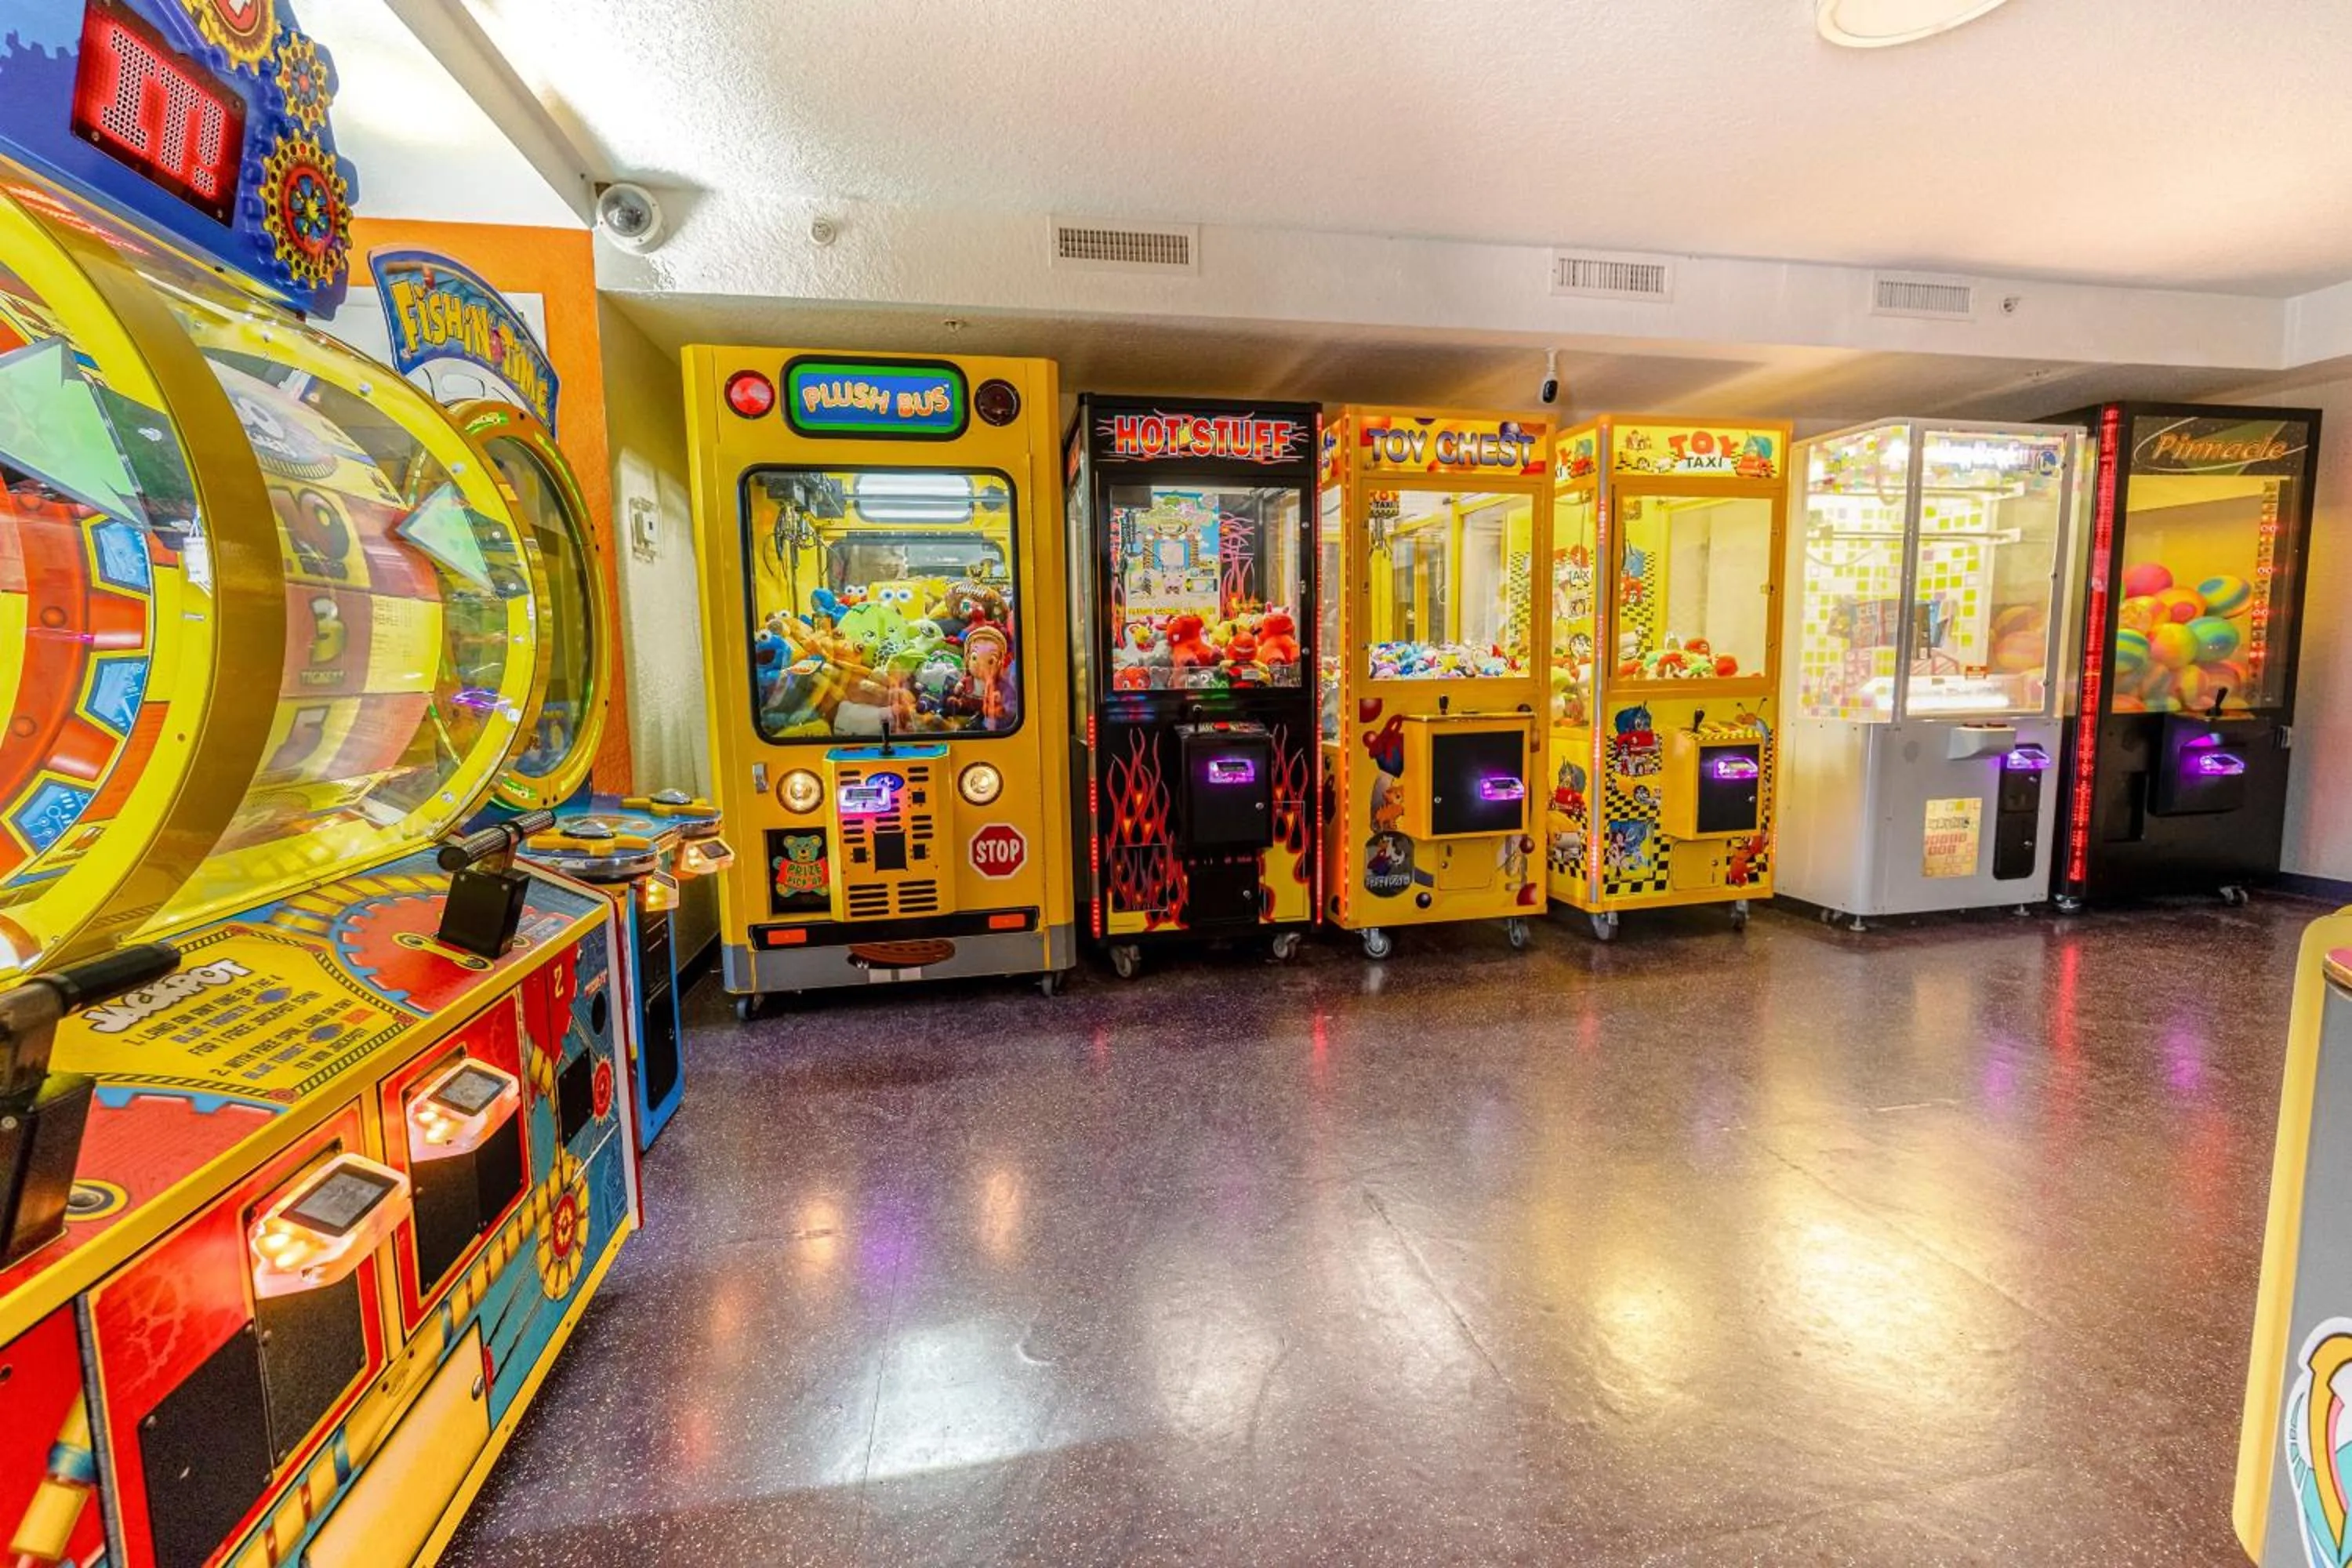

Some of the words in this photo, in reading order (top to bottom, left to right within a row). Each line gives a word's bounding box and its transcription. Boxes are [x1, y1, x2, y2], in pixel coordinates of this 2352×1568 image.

[101, 28, 223, 194] IT!
[803, 382, 890, 414] PLUSH
[1115, 416, 1182, 456] HOT
[1190, 418, 1294, 458] STUFF
[1367, 428, 1428, 463] TOY
[1436, 430, 1535, 467] CHEST
[1668, 430, 1740, 460] TOY
[2152, 433, 2288, 461] Pinnacle
[1686, 456, 1722, 468] TAXI
[309, 596, 347, 665] 3
[976, 839, 1020, 863] STOP
[788, 864, 822, 876] PRIZE
[81, 958, 254, 1034] JACKPOT
[554, 964, 564, 999] 2
[137, 1022, 179, 1040] LAND
[172, 1014, 197, 1025] ON
[189, 1004, 220, 1016] ANY
[234, 986, 253, 996] OF
[249, 978, 275, 989] THE
[169, 1026, 209, 1044] BLUE
[187, 1042, 221, 1056] FOR
[220, 1023, 257, 1040] FREE
[249, 1002, 296, 1026] JACKPOT
[223, 1054, 258, 1069] WITH
[249, 1039, 283, 1054] FREE
[241, 1062, 278, 1080] BLUE
